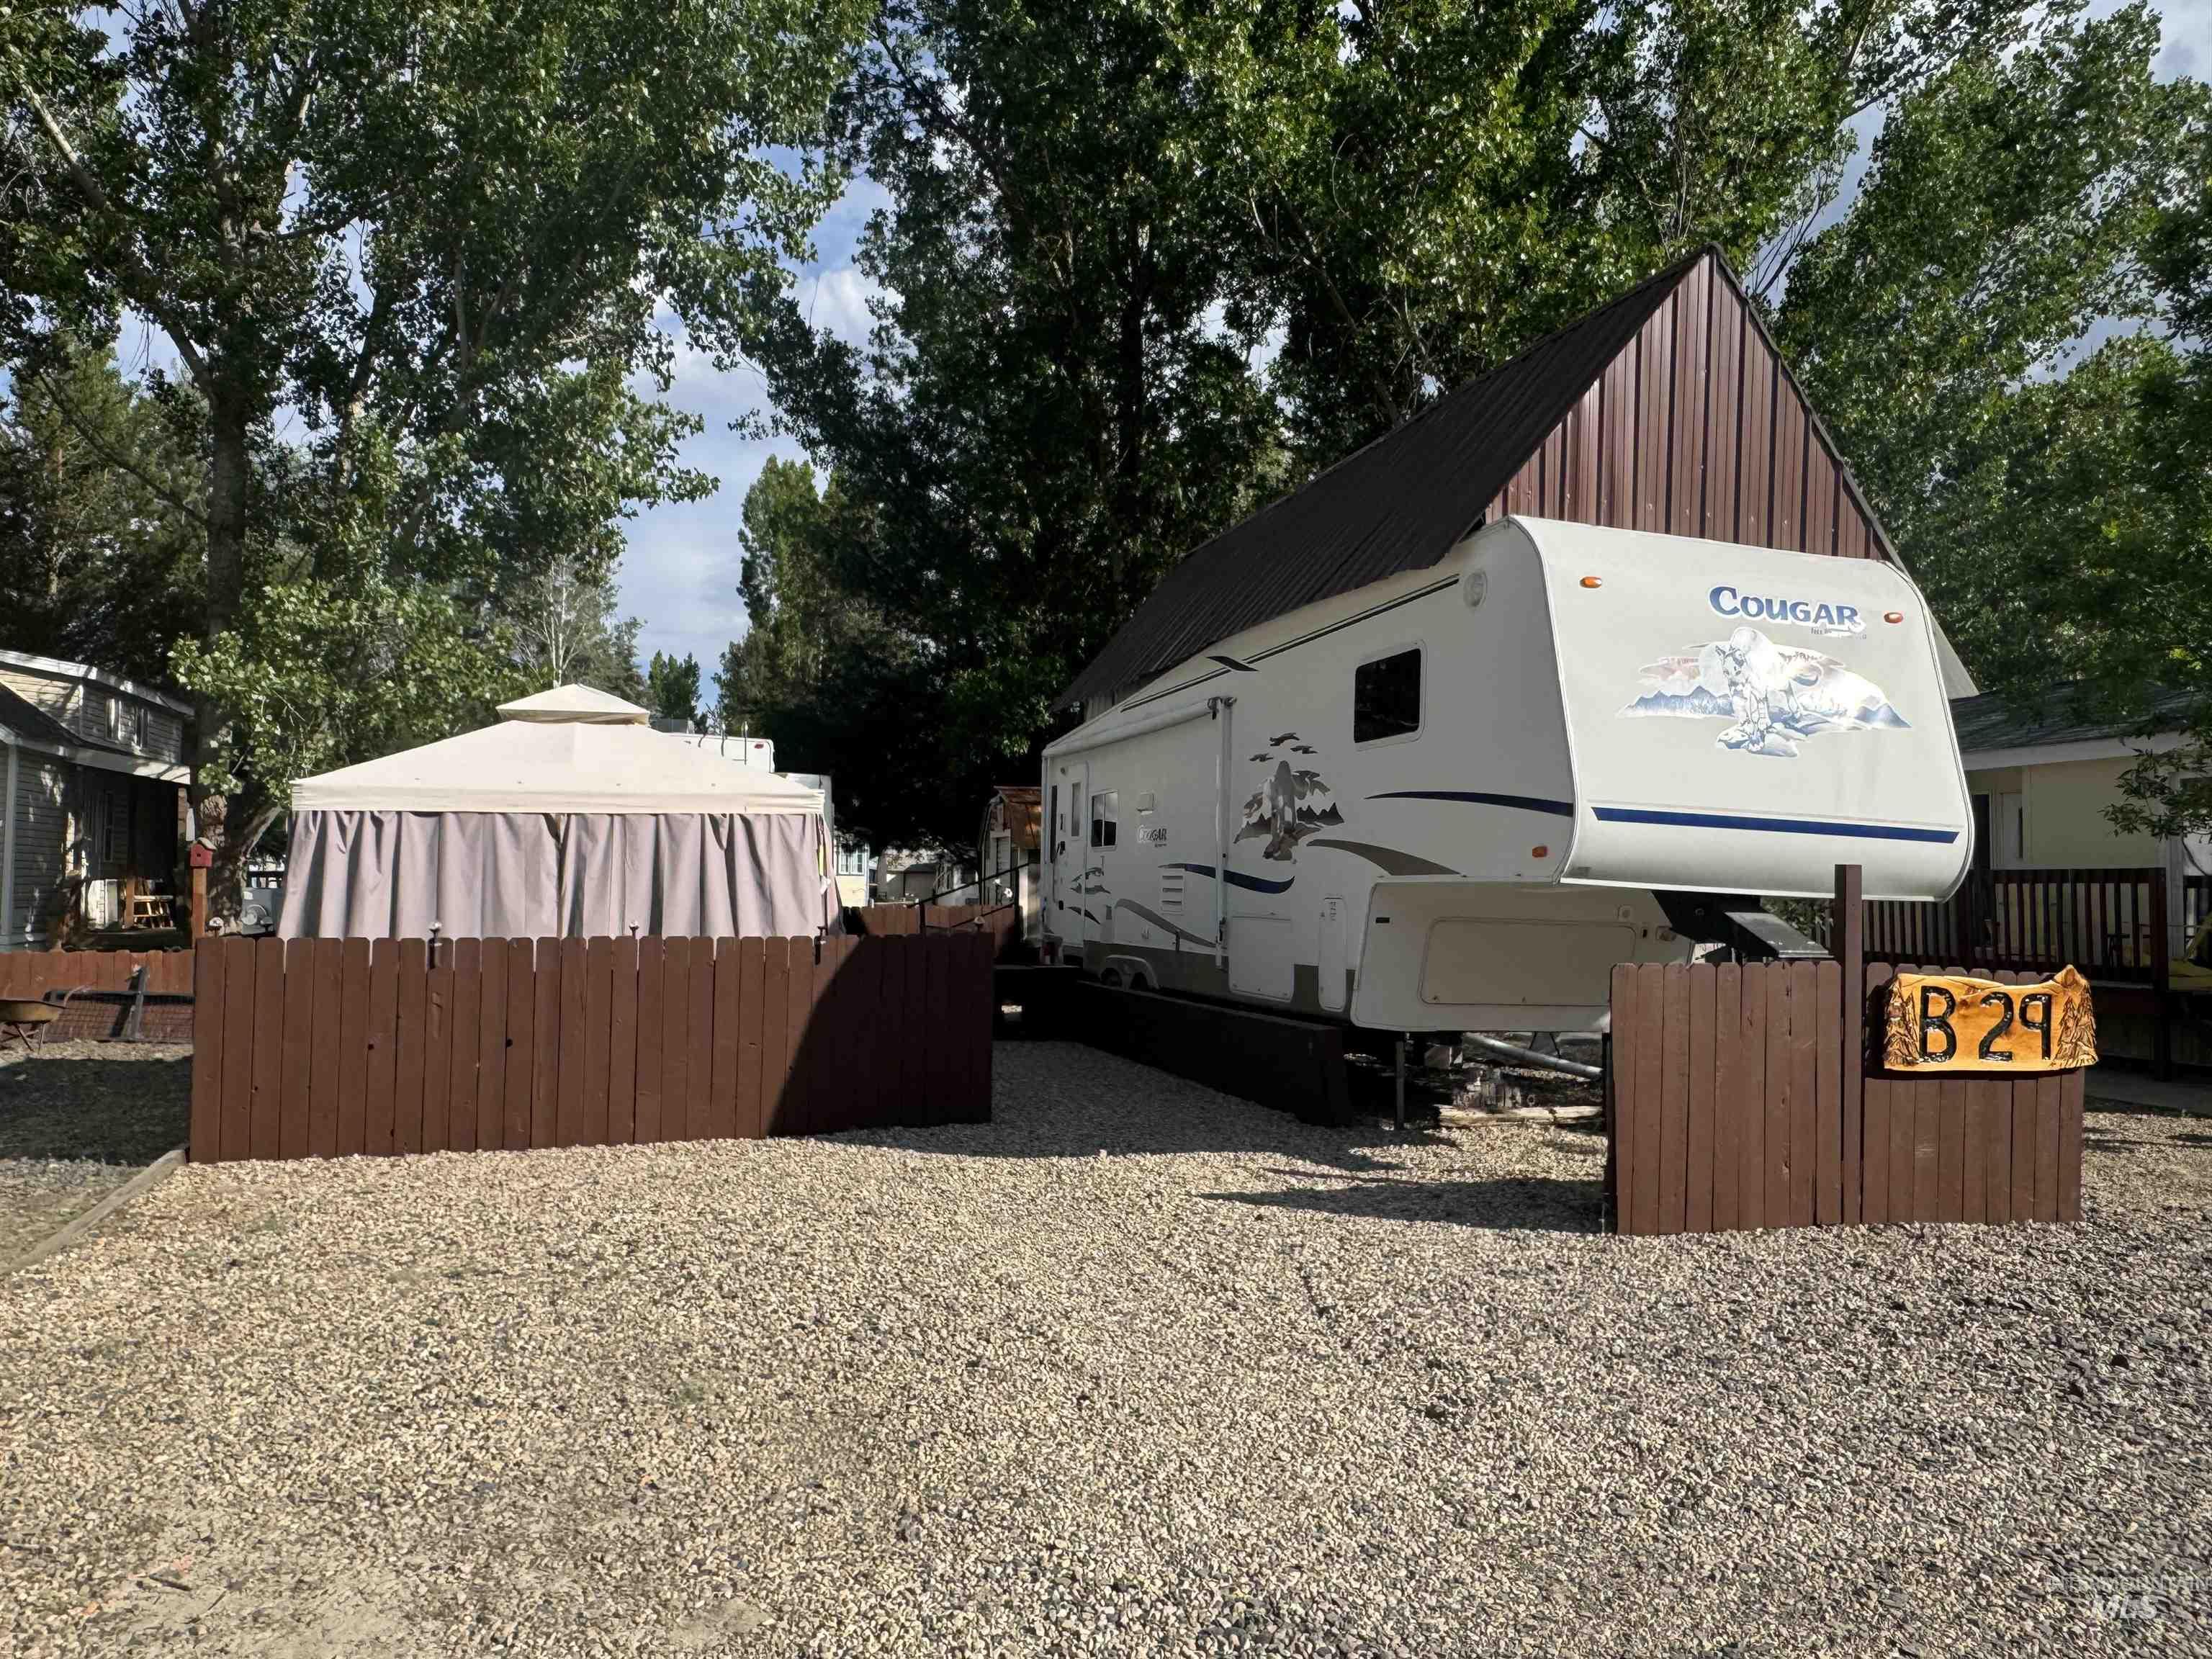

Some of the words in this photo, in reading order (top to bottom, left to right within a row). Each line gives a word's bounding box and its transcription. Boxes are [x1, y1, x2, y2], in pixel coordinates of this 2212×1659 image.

[1709, 585, 1860, 626] COUGAR
[1918, 984, 1958, 1063] B
[1979, 991, 2052, 1061] 29
